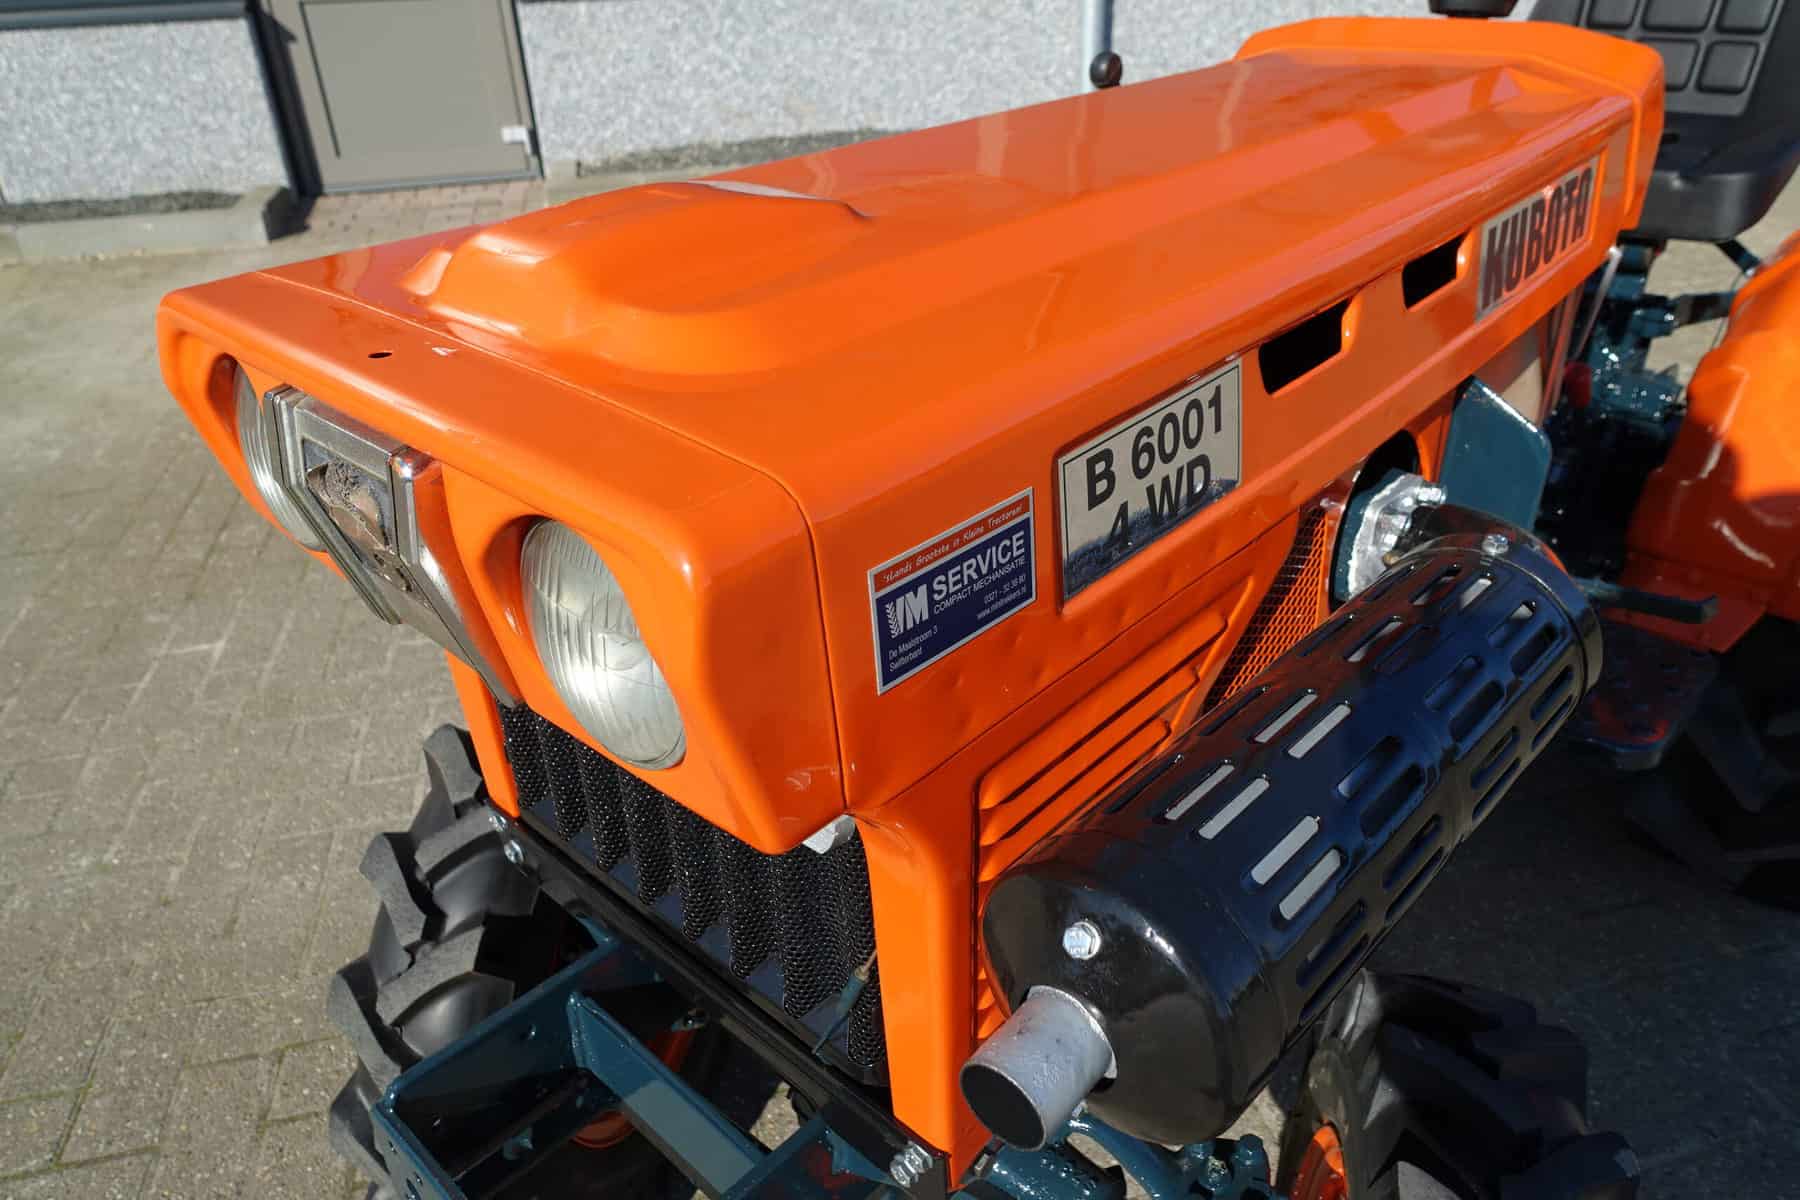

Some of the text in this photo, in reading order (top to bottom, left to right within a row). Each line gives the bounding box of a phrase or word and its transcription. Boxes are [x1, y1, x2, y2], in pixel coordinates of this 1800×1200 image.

[1481, 167, 1593, 310] KUBOTA
[1086, 385, 1222, 511] B 6001
[1106, 454, 1211, 549] 4 WD
[932, 531, 1025, 601] SERVICE
[934, 586, 972, 615] COMPACT
